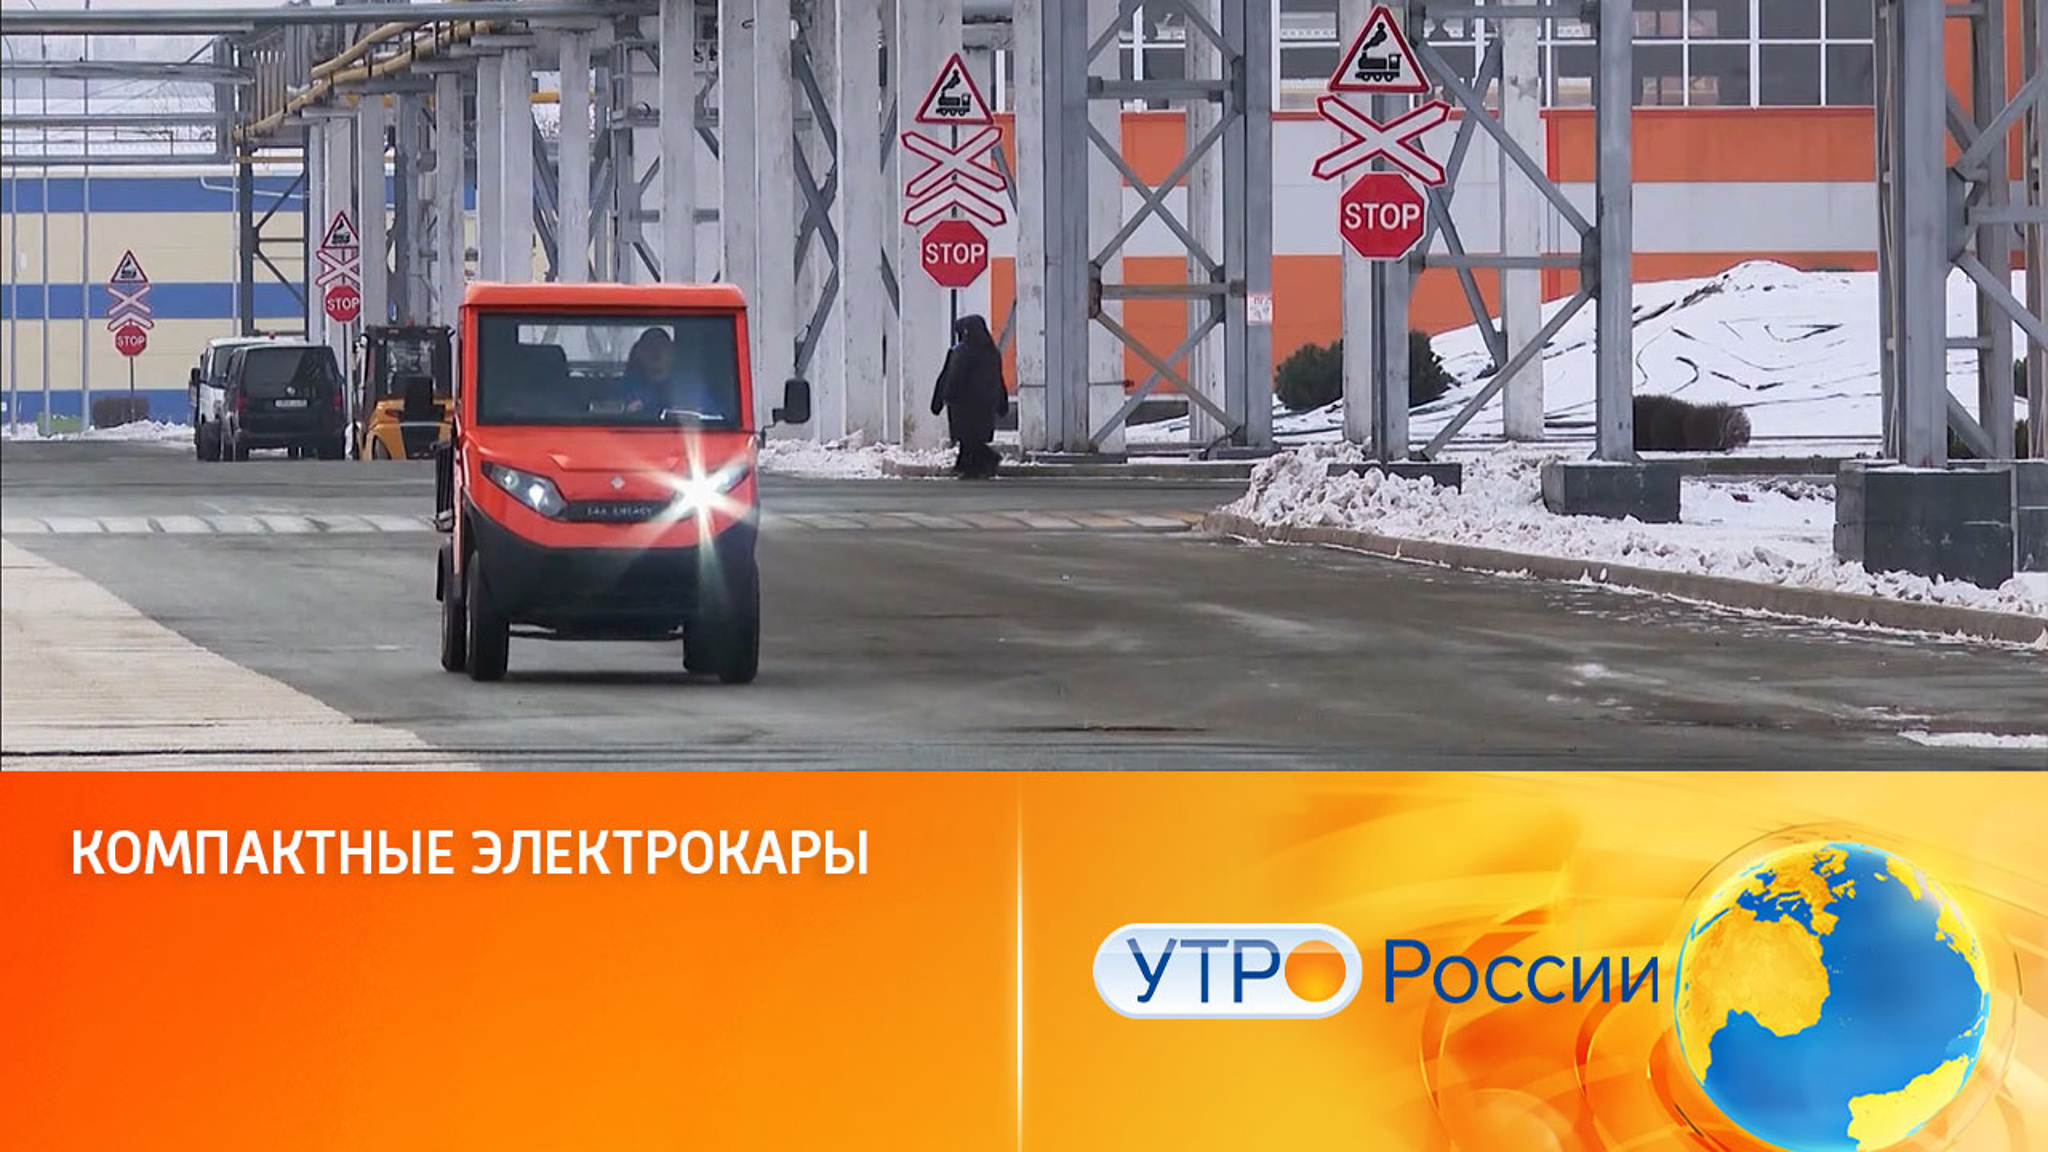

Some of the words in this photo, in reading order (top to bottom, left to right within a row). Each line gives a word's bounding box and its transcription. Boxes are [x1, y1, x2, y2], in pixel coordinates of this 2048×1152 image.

[1344, 202, 1421, 230] STOP
[925, 242, 985, 265] STOP
[327, 297, 360, 312] STOP
[115, 334, 145, 347] STOP
